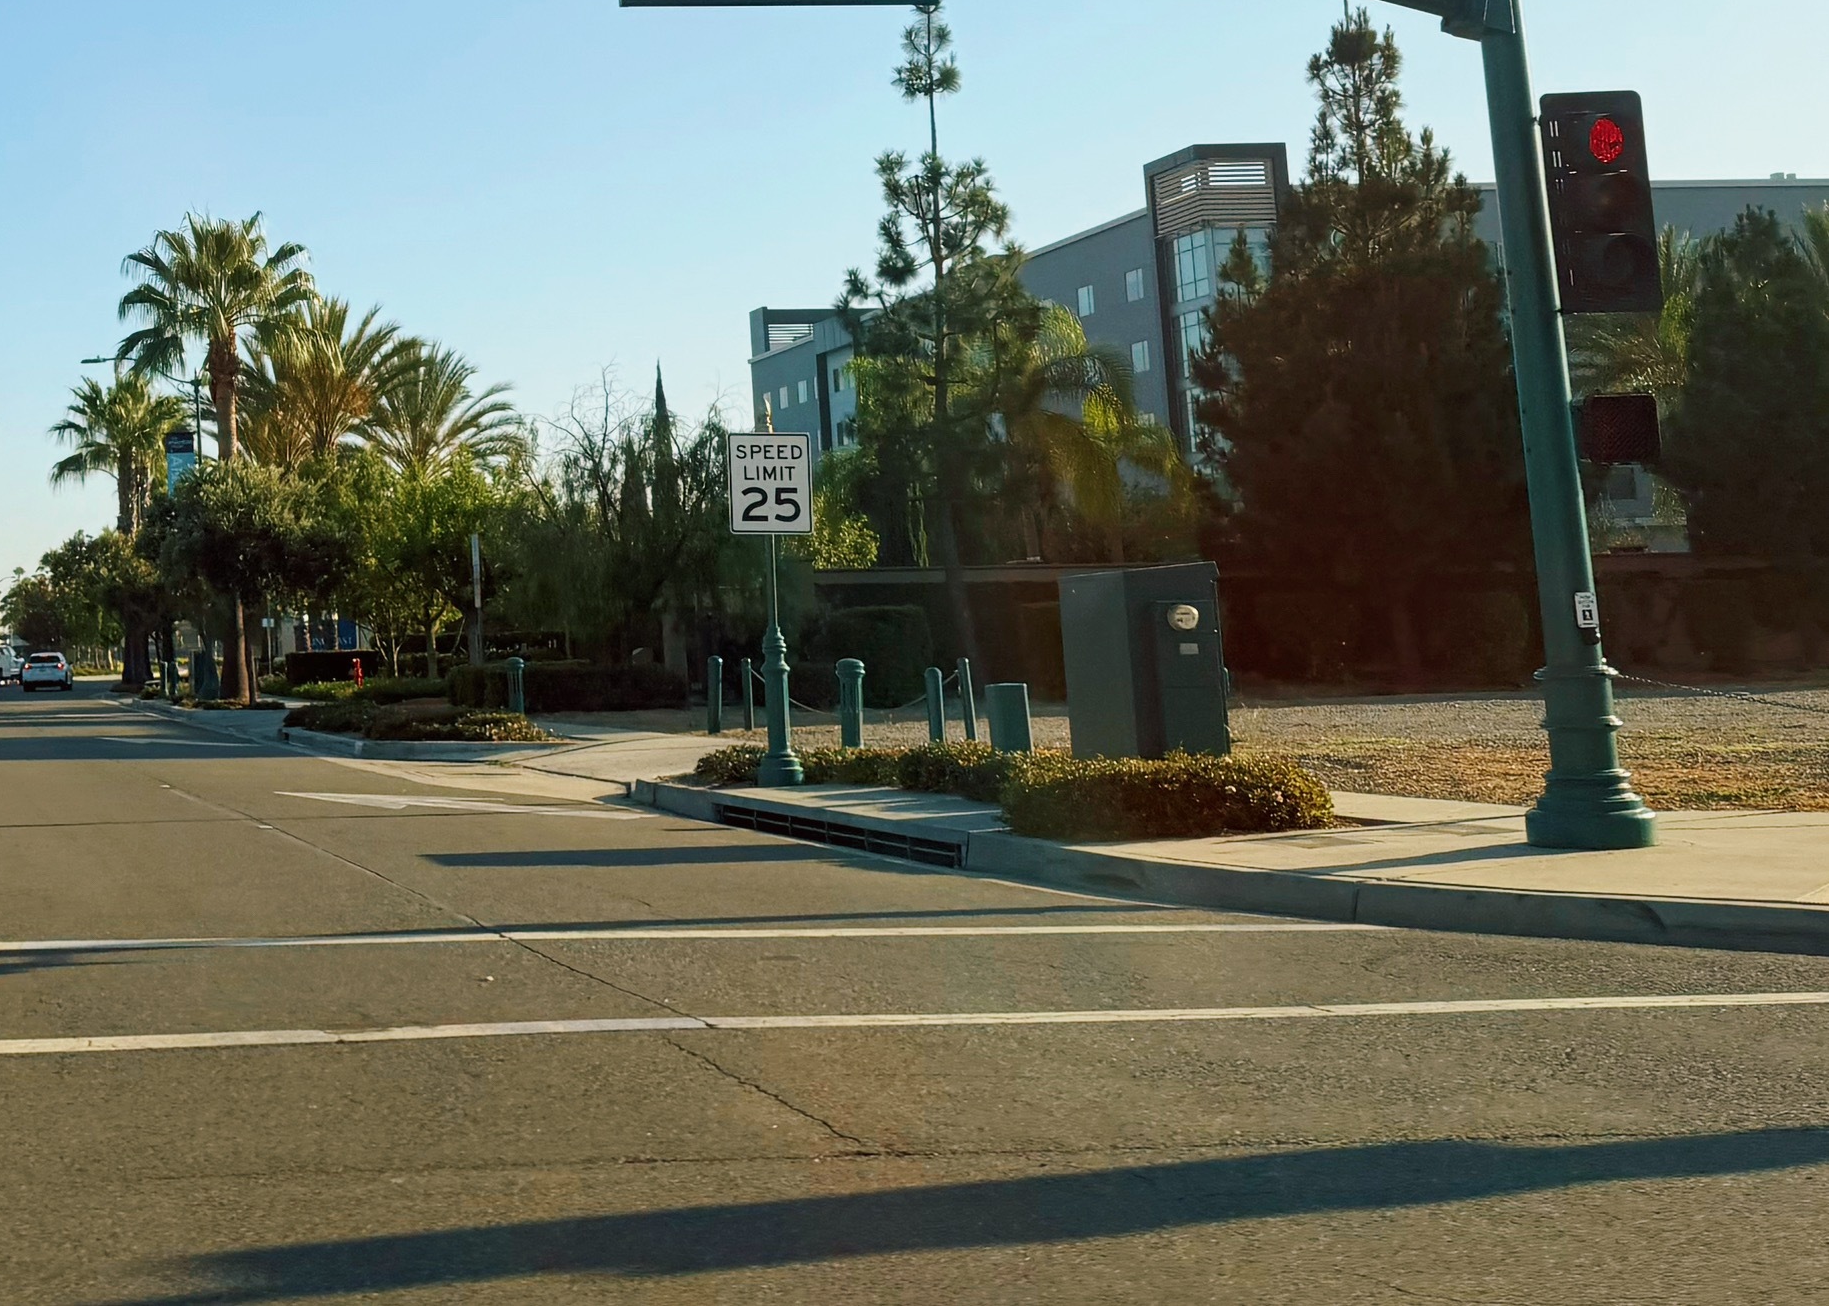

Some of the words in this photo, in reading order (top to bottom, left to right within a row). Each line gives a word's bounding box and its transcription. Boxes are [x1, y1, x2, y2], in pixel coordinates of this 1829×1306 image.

[736, 444, 803, 460] SPEED
[743, 465, 796, 481] LIMIT
[741, 486, 801, 523] 25
